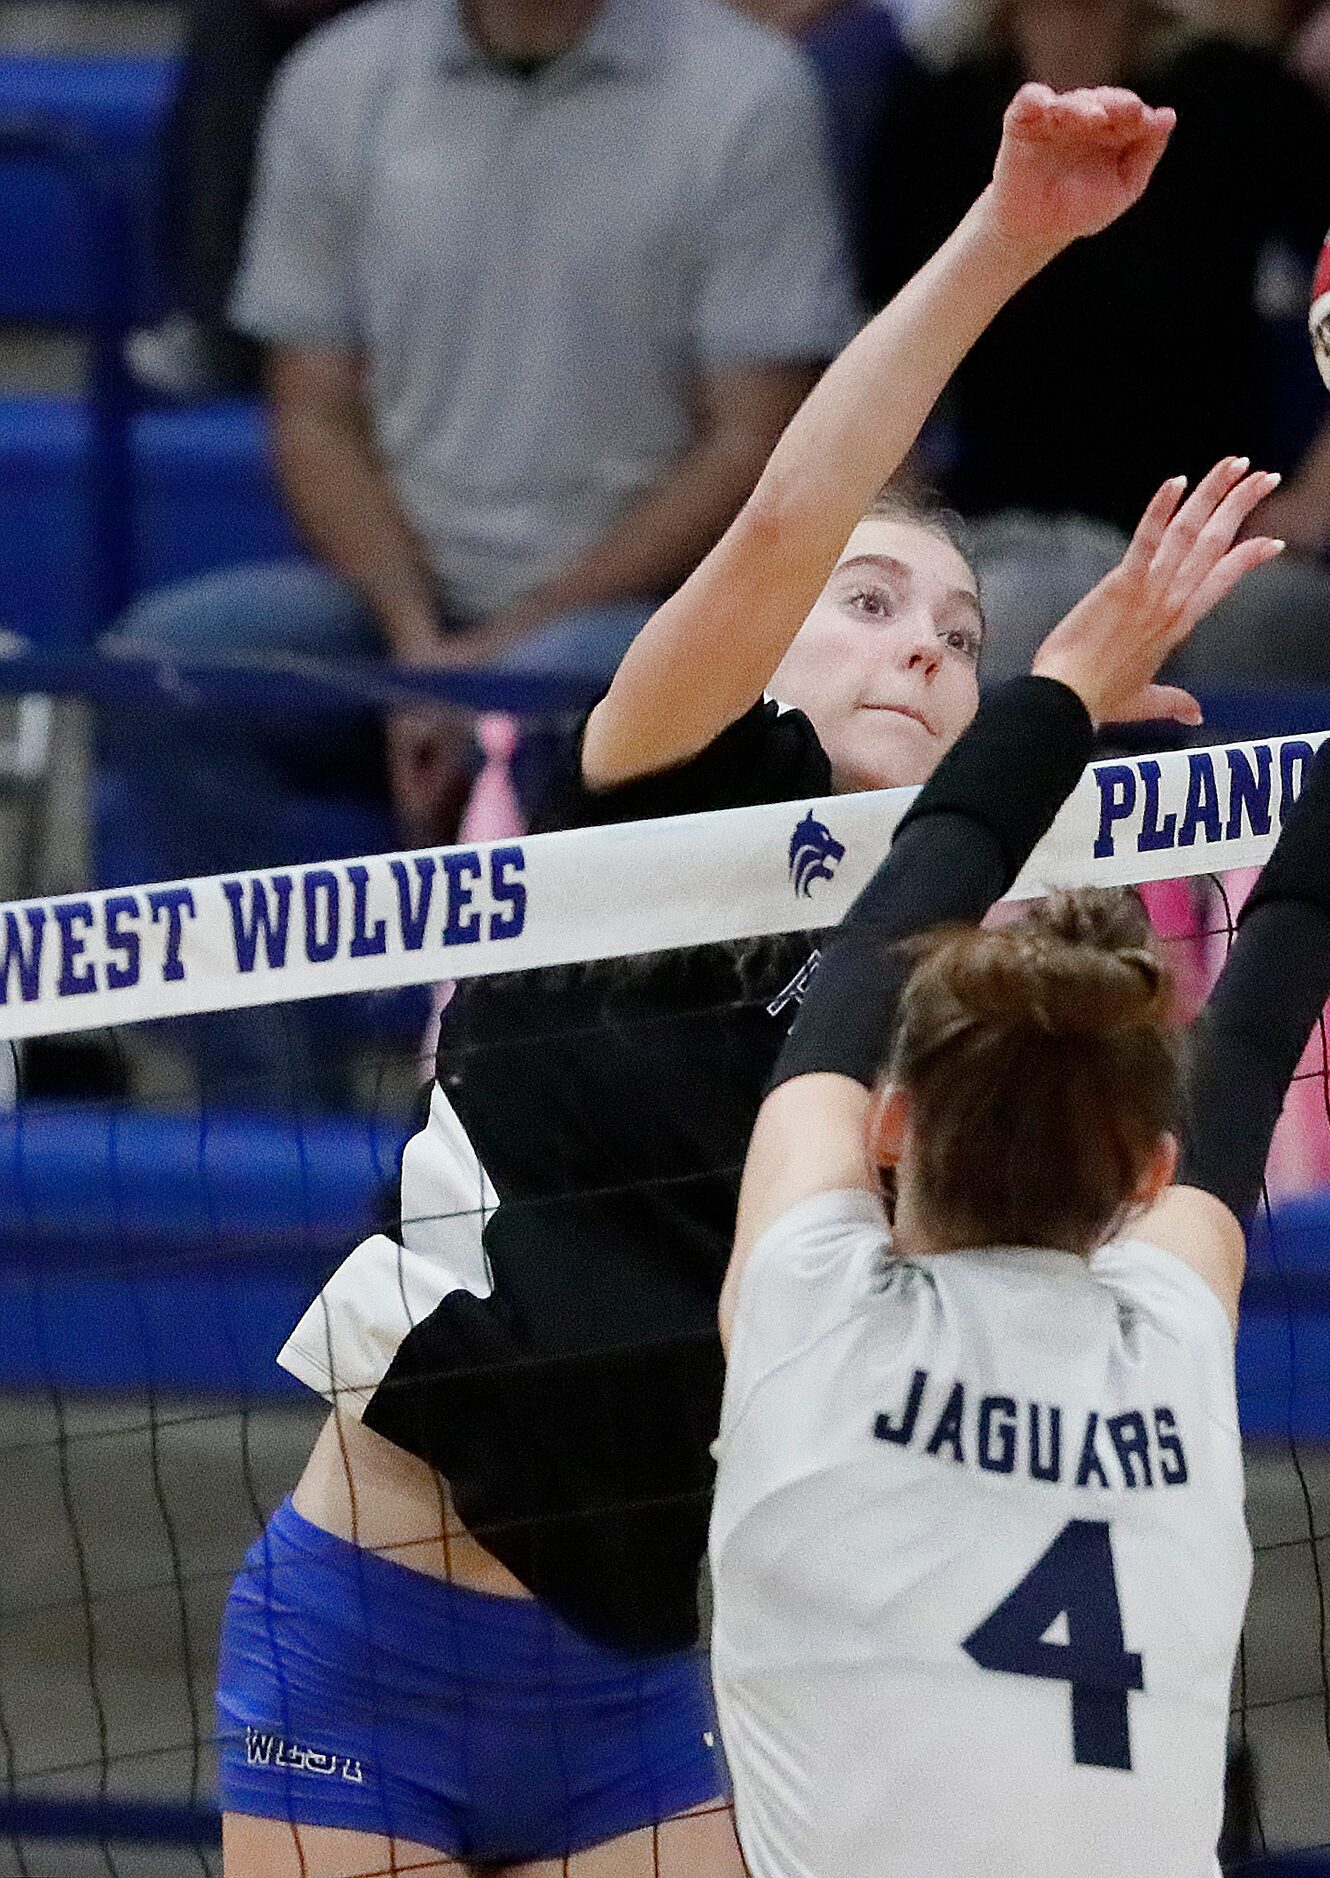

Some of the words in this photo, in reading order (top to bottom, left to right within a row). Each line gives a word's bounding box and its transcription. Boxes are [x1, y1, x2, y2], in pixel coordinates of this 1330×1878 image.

[221, 846, 527, 973] WOLVES
[873, 1369, 1189, 1488] JAGUARS
[960, 1520, 1144, 1771] 4
